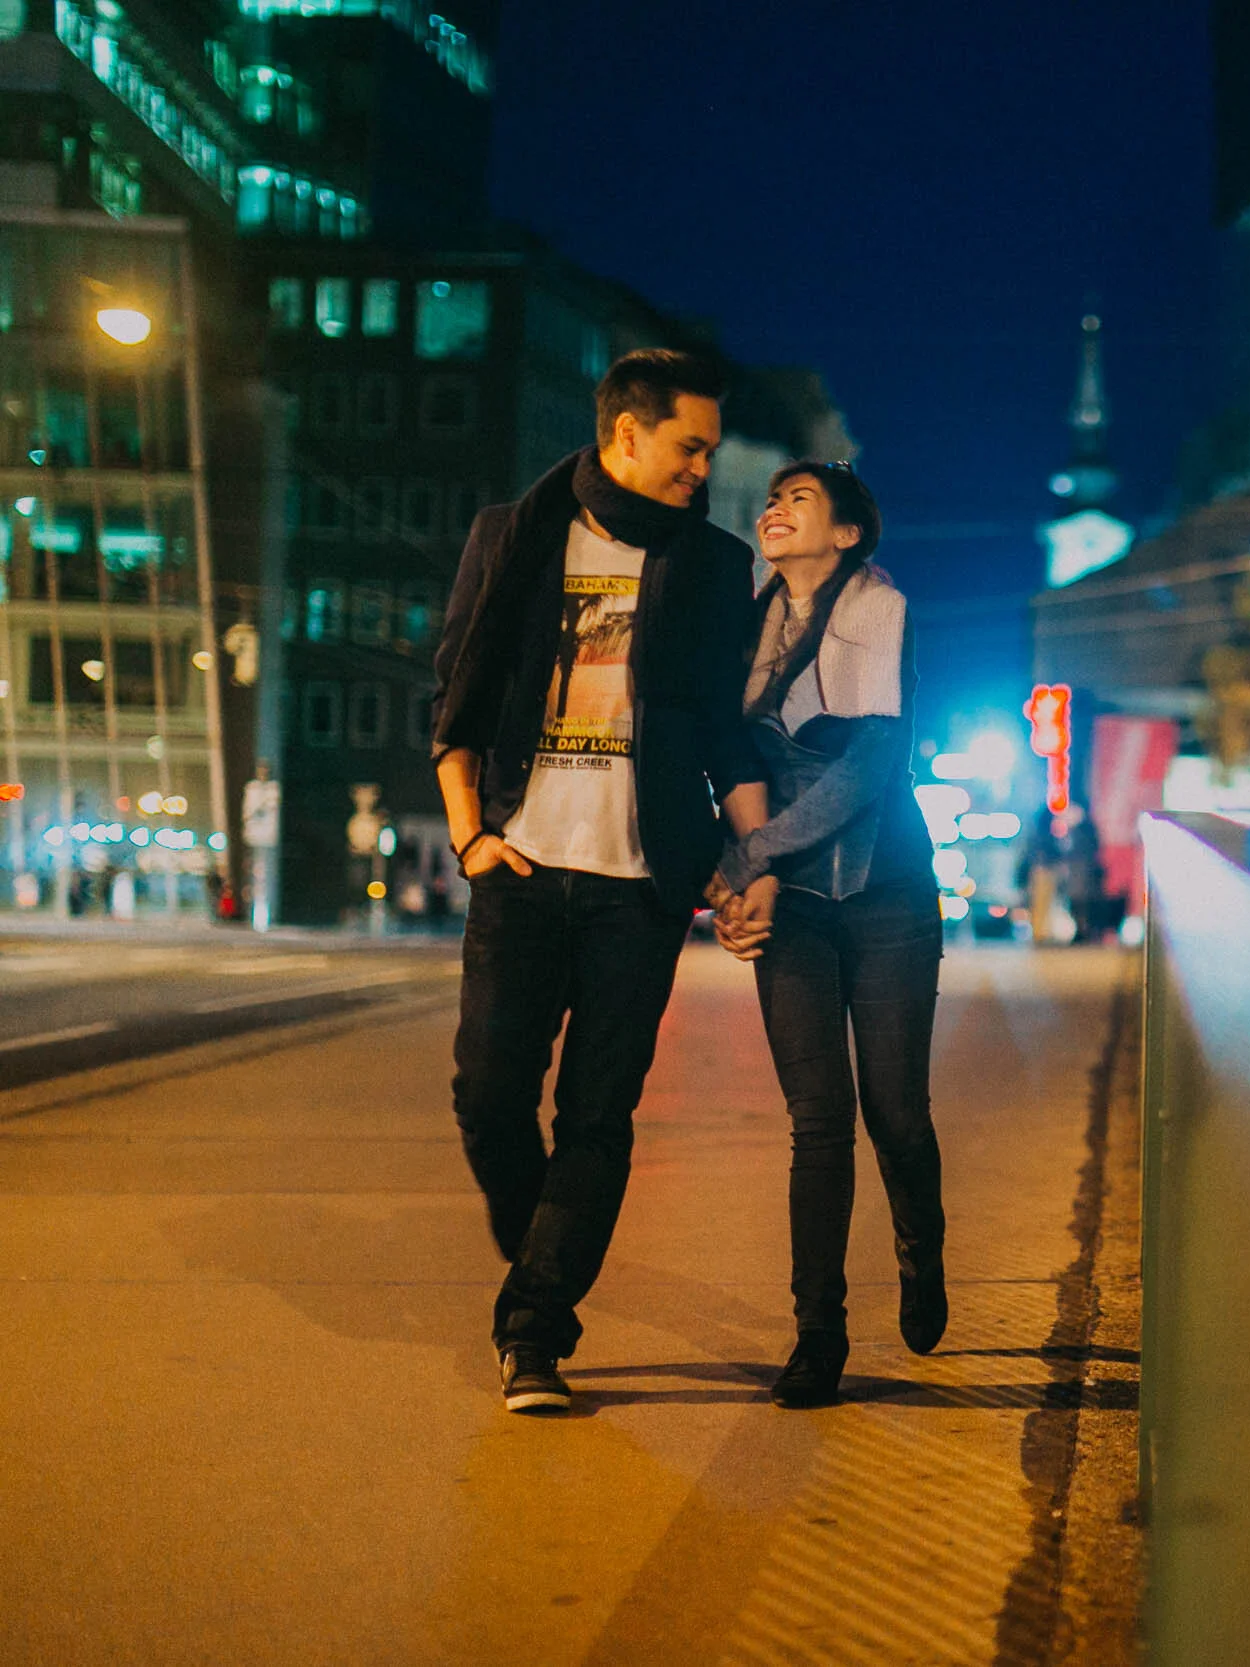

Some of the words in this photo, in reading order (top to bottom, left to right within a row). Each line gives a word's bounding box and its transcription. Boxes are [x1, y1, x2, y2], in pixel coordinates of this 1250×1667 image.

[556, 738, 587, 751] DAY
[591, 739, 631, 753] LONG
[540, 755, 573, 765] FRESH
[576, 757, 612, 767] CREEK
